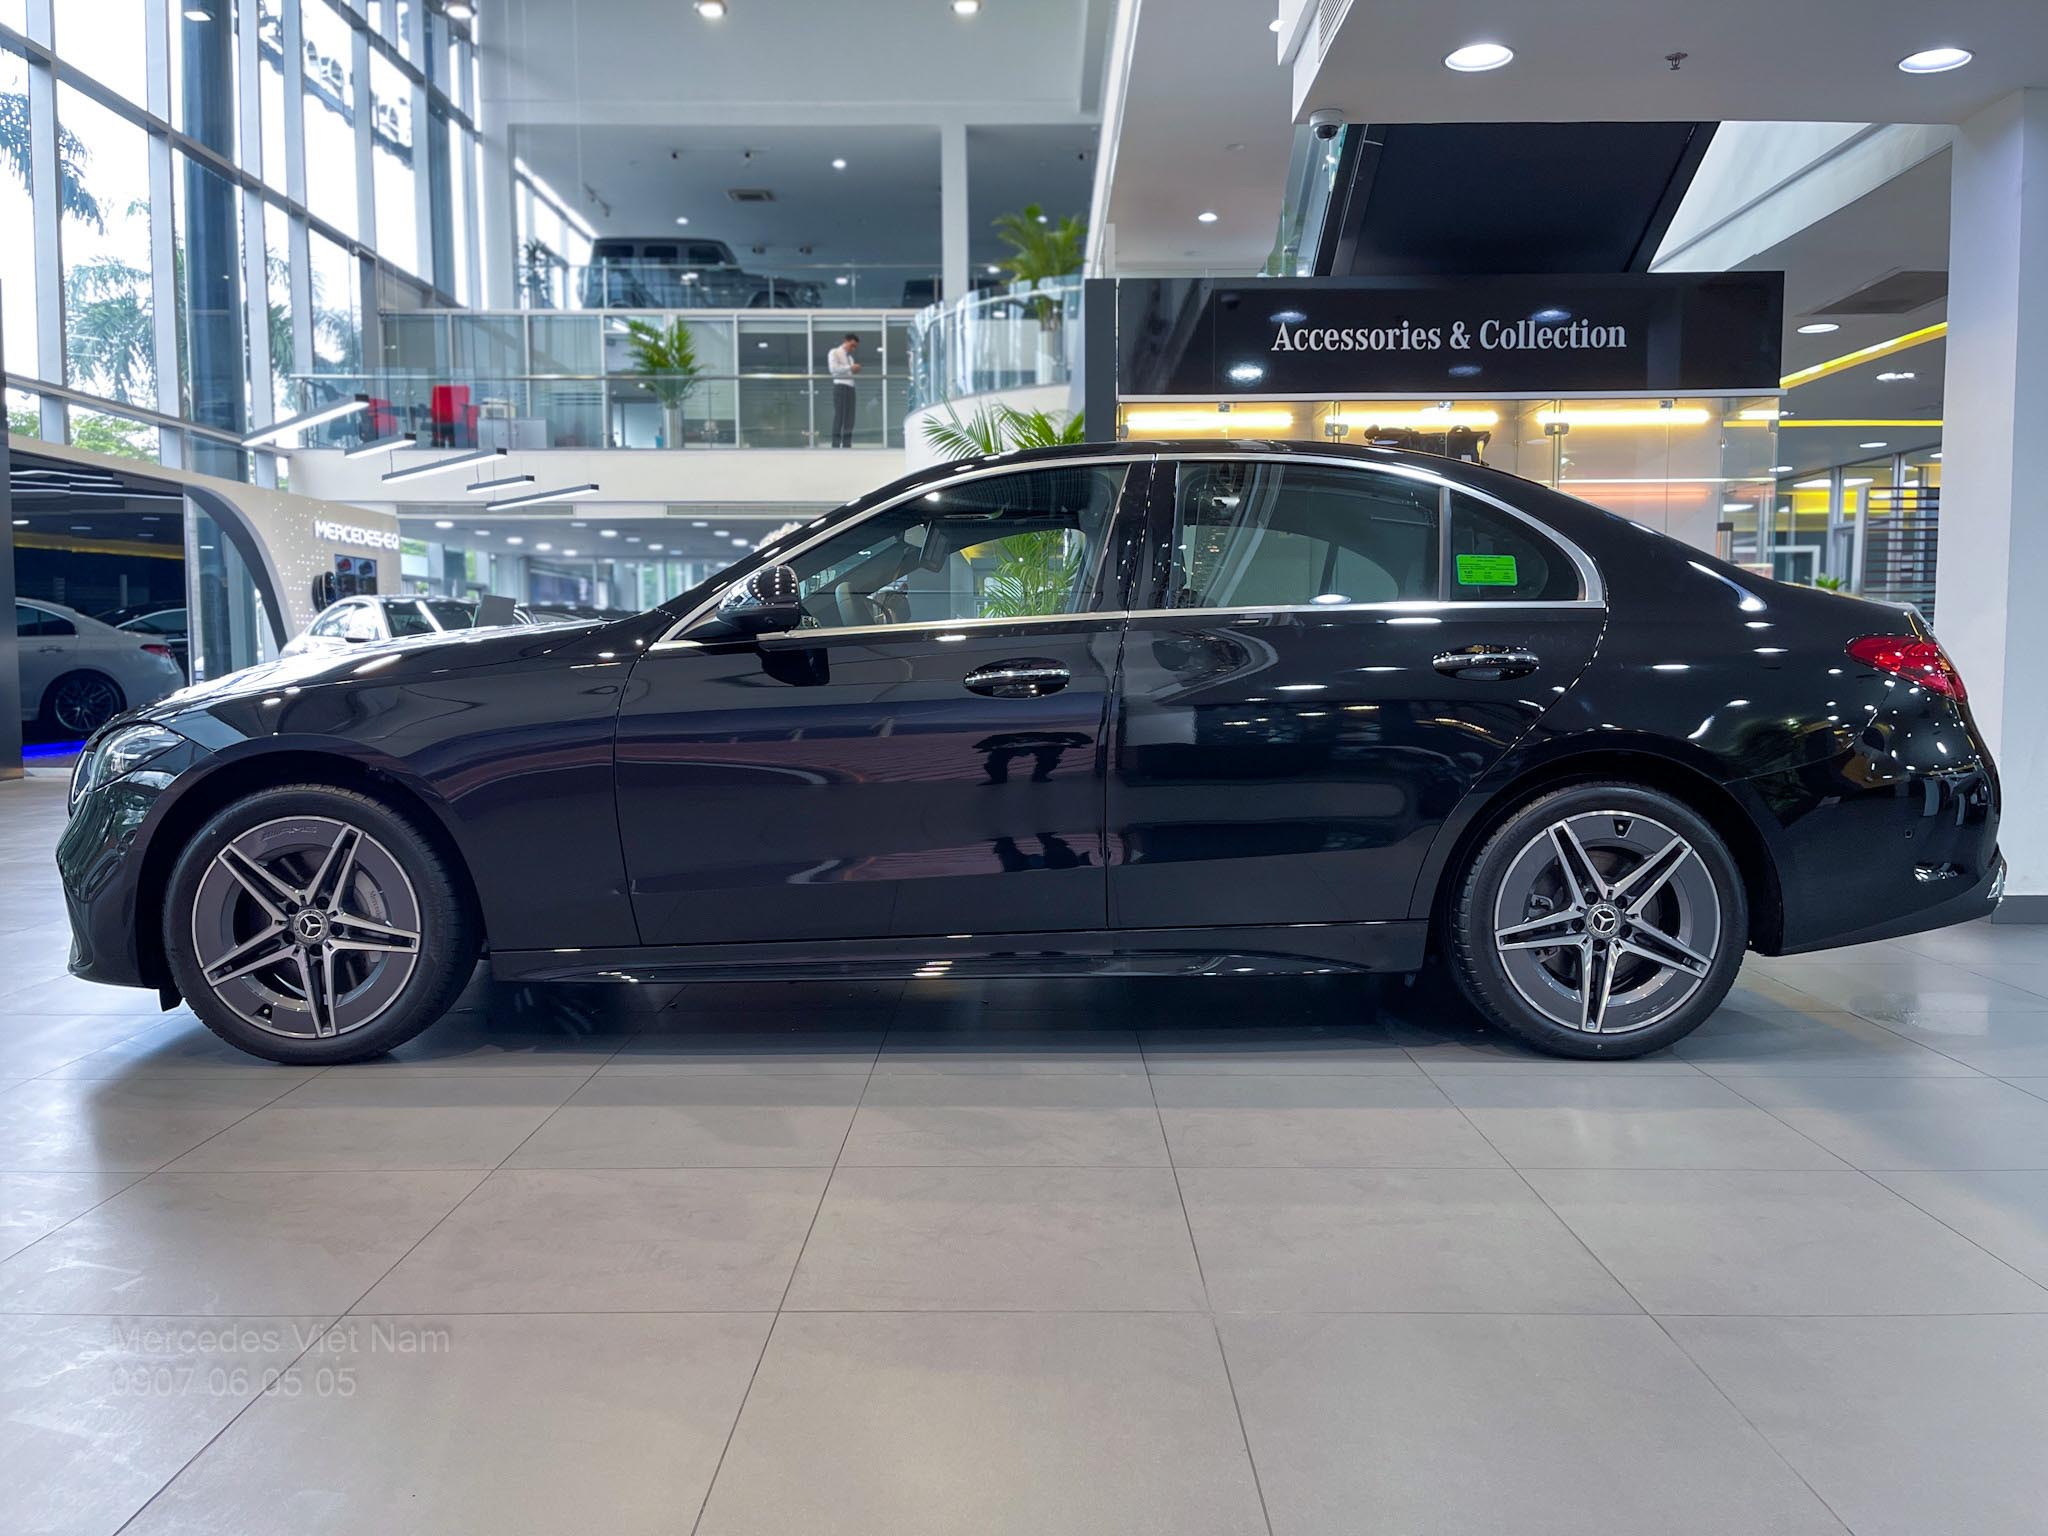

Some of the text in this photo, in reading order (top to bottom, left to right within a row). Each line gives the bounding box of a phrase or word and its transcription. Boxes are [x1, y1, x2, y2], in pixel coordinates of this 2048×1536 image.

[1271, 318, 1627, 351] Accessories & Collection
